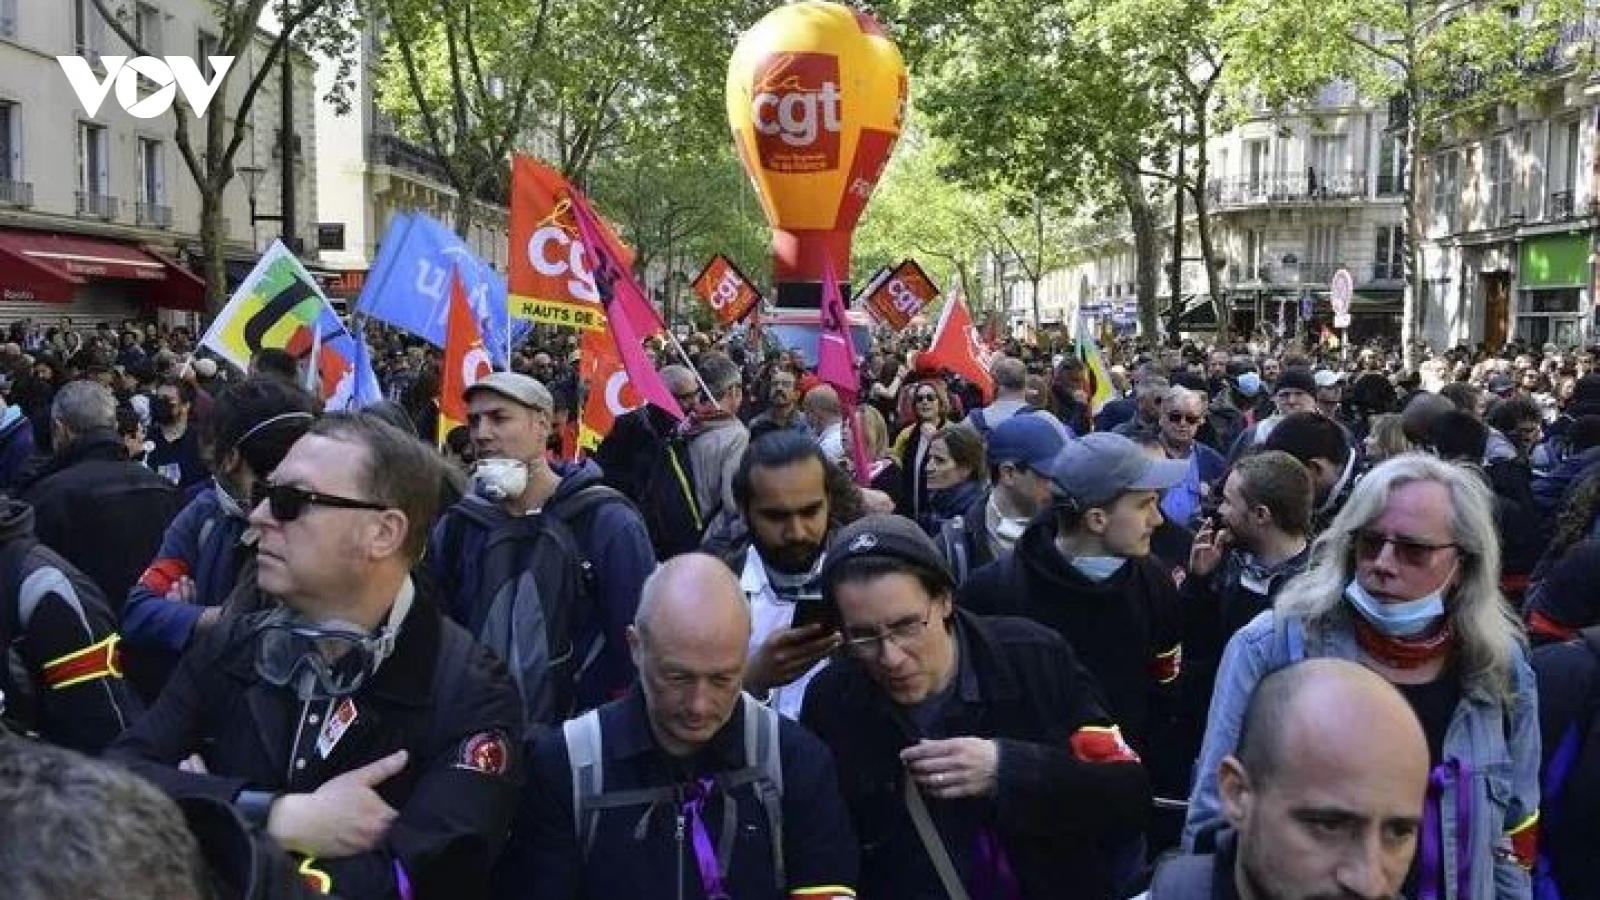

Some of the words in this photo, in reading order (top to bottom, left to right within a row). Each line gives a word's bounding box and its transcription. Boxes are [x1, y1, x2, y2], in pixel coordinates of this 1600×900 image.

[754, 81, 843, 146] cgt
[528, 226, 601, 304] cg
[711, 268, 743, 311] cgt
[888, 279, 923, 318] cgt
[522, 303, 570, 322] HAUTS
[574, 311, 594, 324] DE
